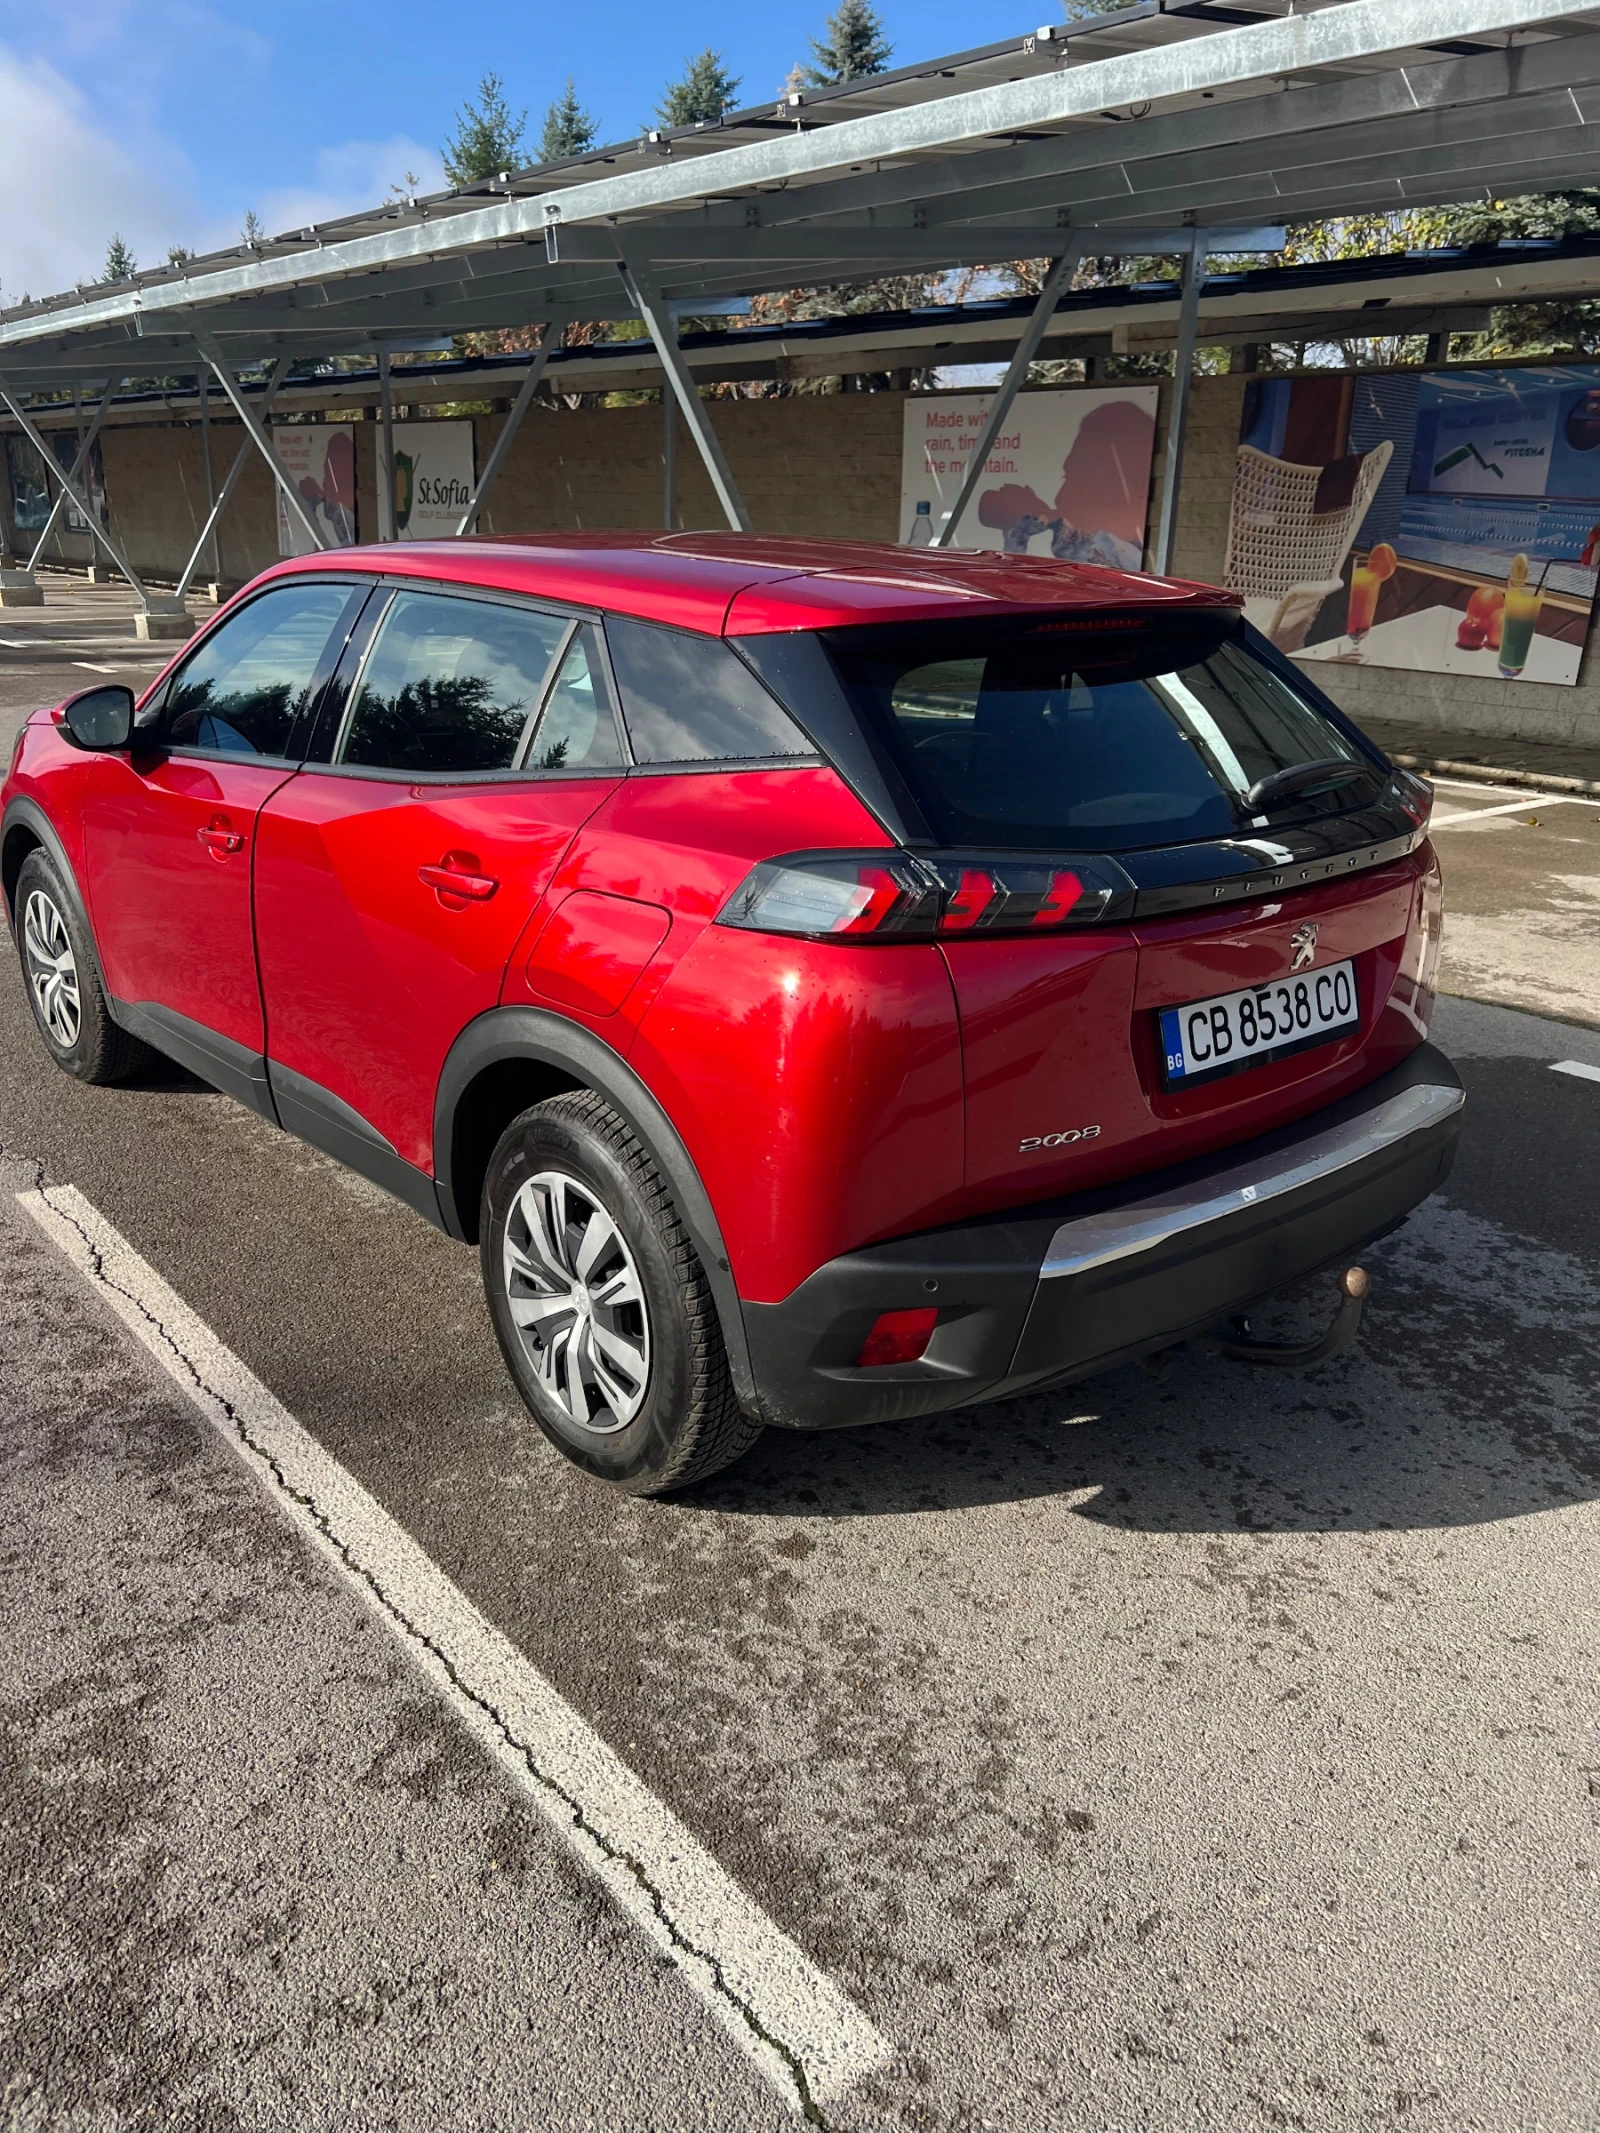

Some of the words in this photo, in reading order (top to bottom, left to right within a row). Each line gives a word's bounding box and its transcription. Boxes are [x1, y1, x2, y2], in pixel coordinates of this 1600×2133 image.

[926, 411, 964, 428] Made
[926, 435, 955, 453] rain,
[958, 434, 979, 450] tim
[994, 432, 1020, 450] and
[925, 459, 946, 473] the
[1213, 850, 1379, 898] PEUGEOT
[1187, 1004, 1233, 1062] CB
[1238, 981, 1312, 1047] 8538
[1315, 970, 1352, 1022] CO
[1167, 1052, 1184, 1071] BG
[1018, 1125, 1102, 1153] 2008
